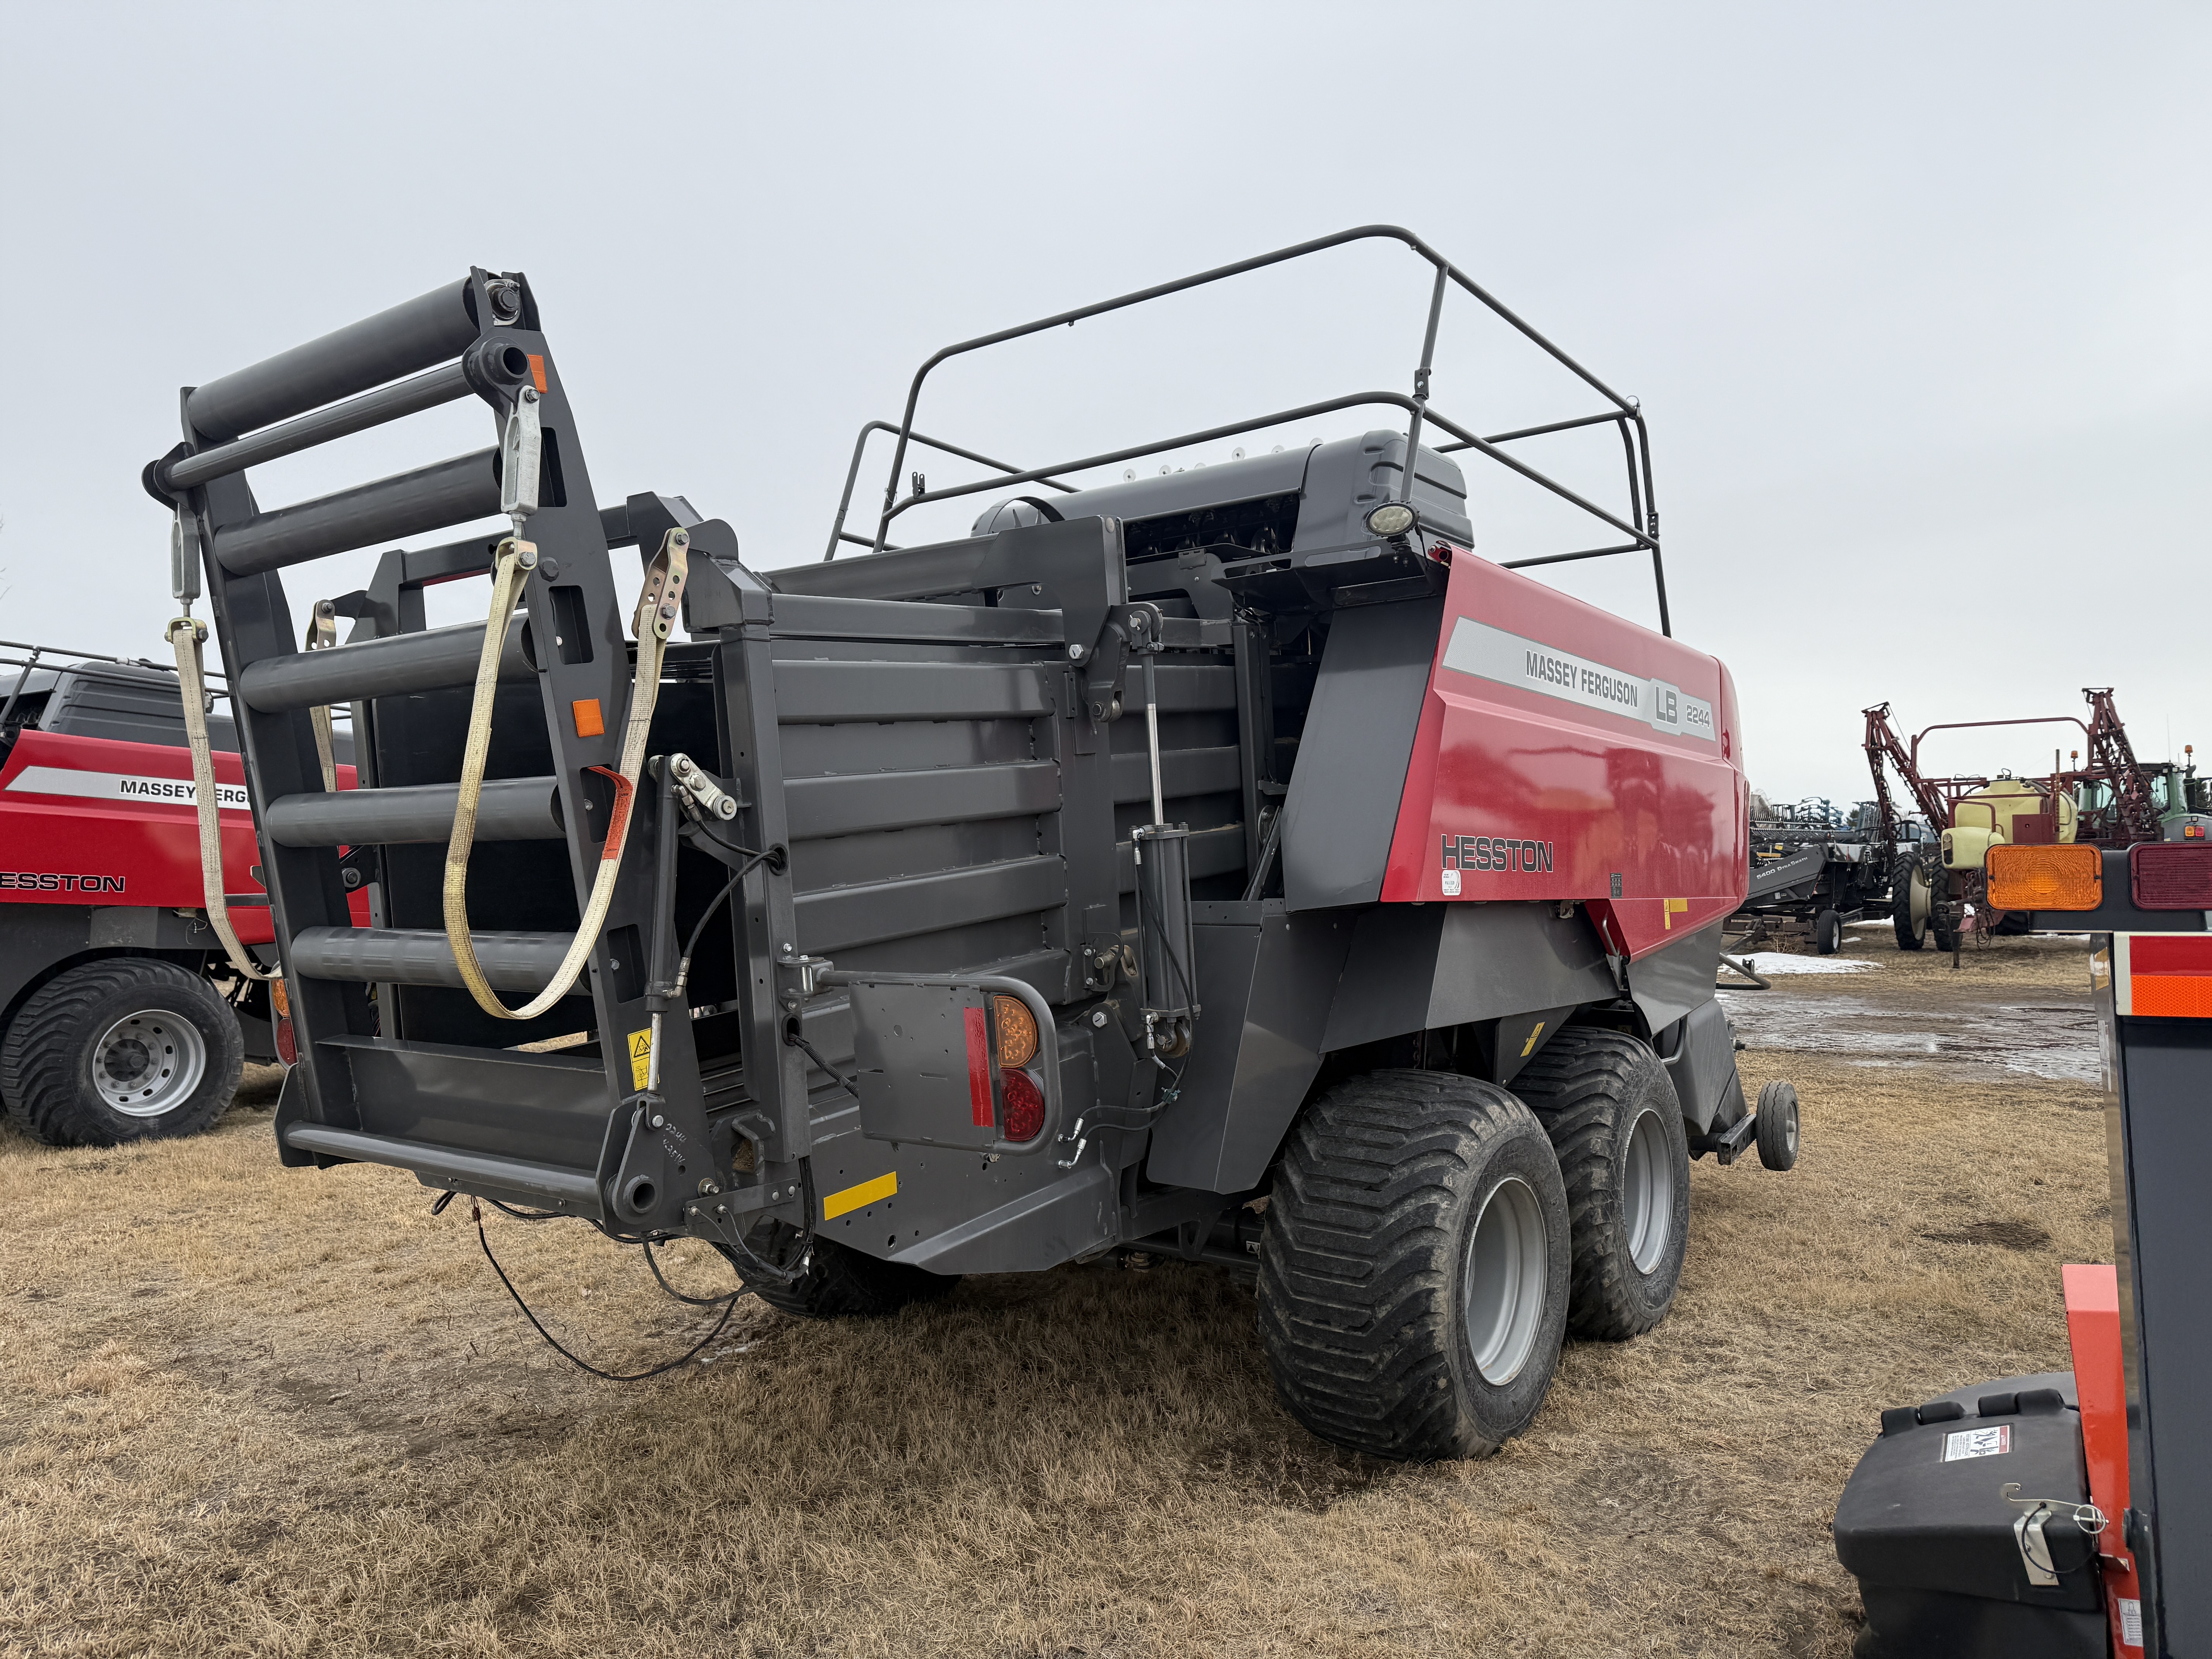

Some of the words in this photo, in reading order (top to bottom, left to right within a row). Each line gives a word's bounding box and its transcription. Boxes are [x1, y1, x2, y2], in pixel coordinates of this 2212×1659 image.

[1526, 650, 1577, 689] MASSEY
[1582, 668, 1637, 707] FERGUSON
[1656, 686, 1678, 725] LB
[1686, 704, 1710, 728] 2244
[120, 780, 196, 799] MASSEY
[216, 789, 250, 803] ERG
[1441, 834, 1553, 872] HESSTON
[0, 872, 125, 893] ESSTON
[1757, 869, 1776, 879] 5400
